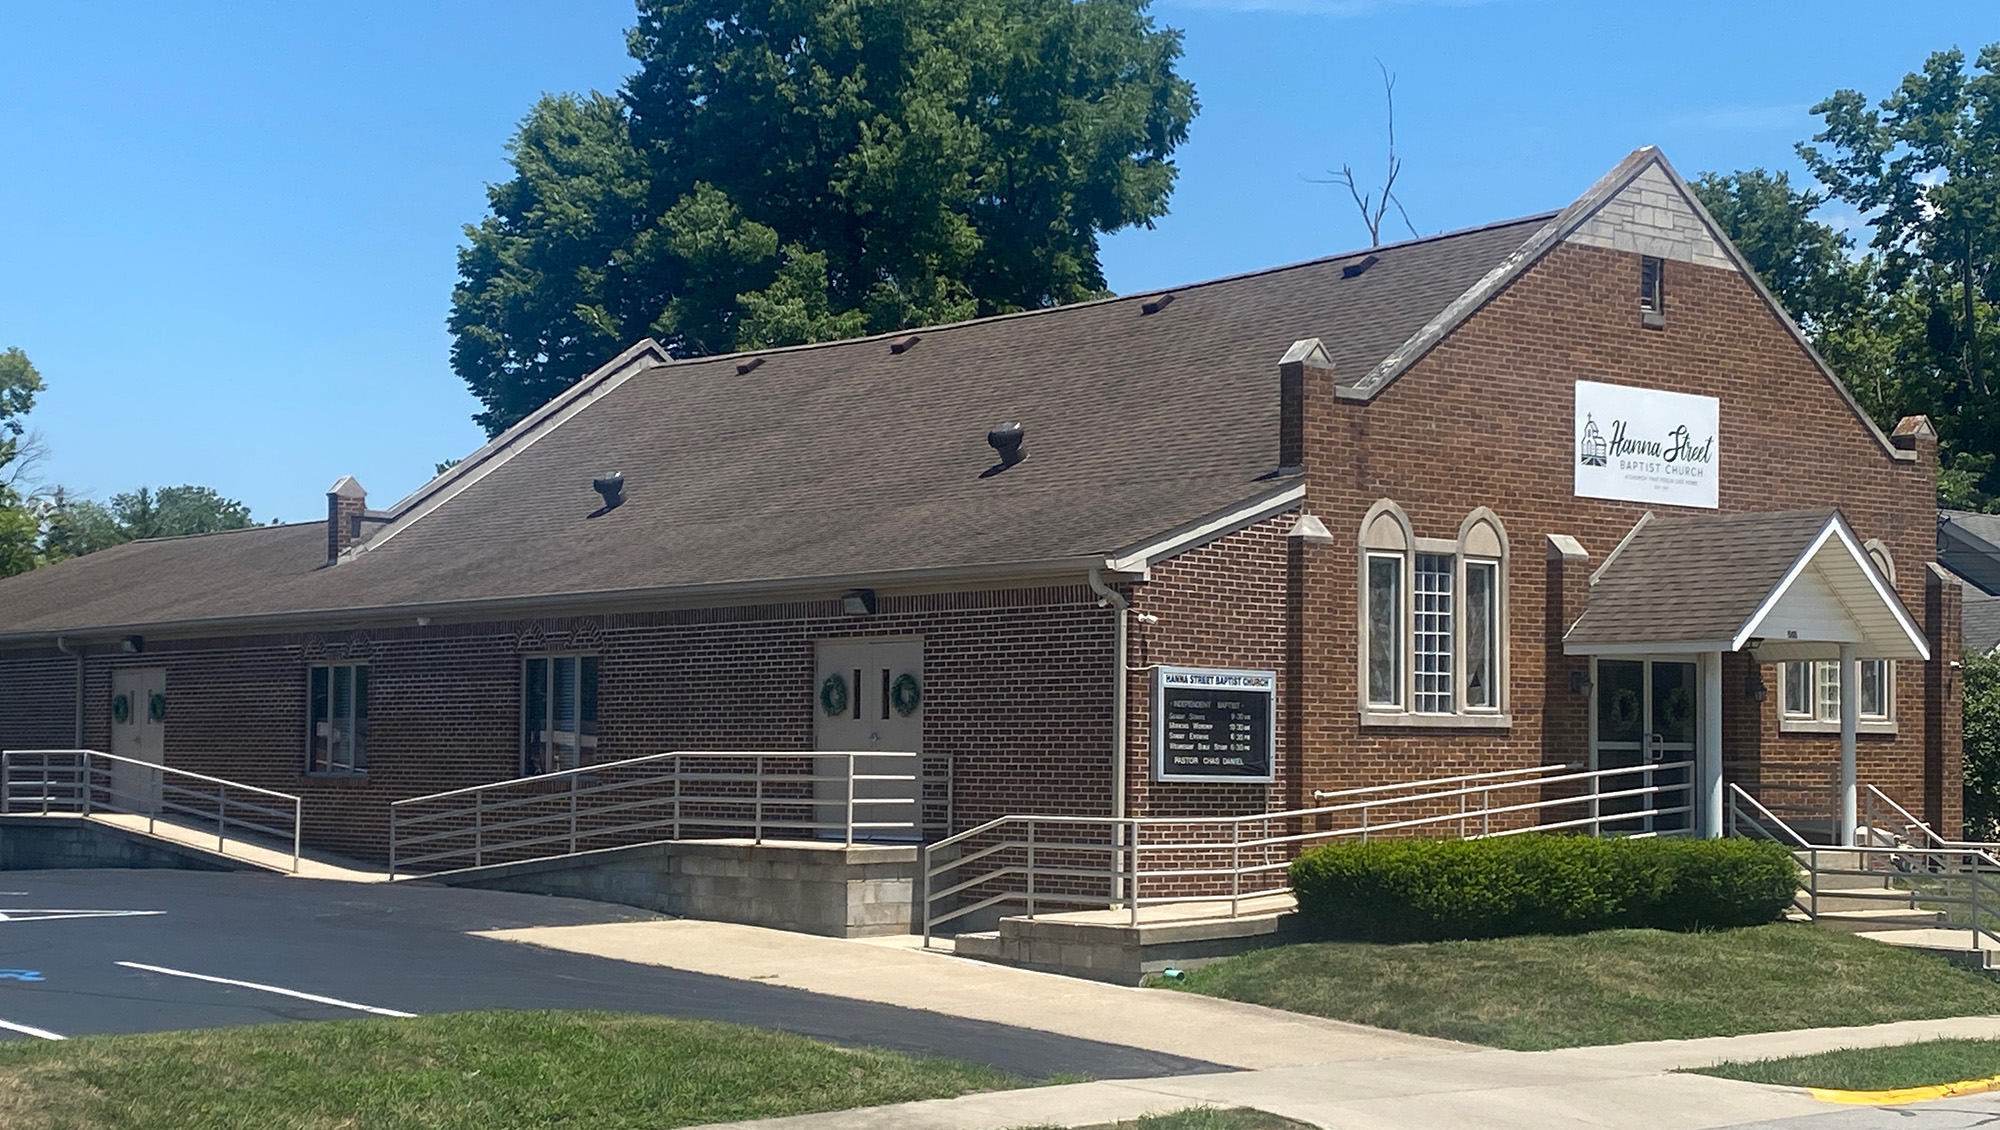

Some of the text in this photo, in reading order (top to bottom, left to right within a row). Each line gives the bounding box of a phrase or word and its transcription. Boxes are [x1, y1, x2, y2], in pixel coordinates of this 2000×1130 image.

[1609, 419, 1714, 464] Hanna Street
[1619, 459, 1704, 477] BAPTIST CHURCH
[1166, 674, 1269, 687] HANNA STREET BAPTIST CHURCH
[1174, 756, 1199, 764] PASTOR
[1222, 757, 1244, 766] DANIEL
